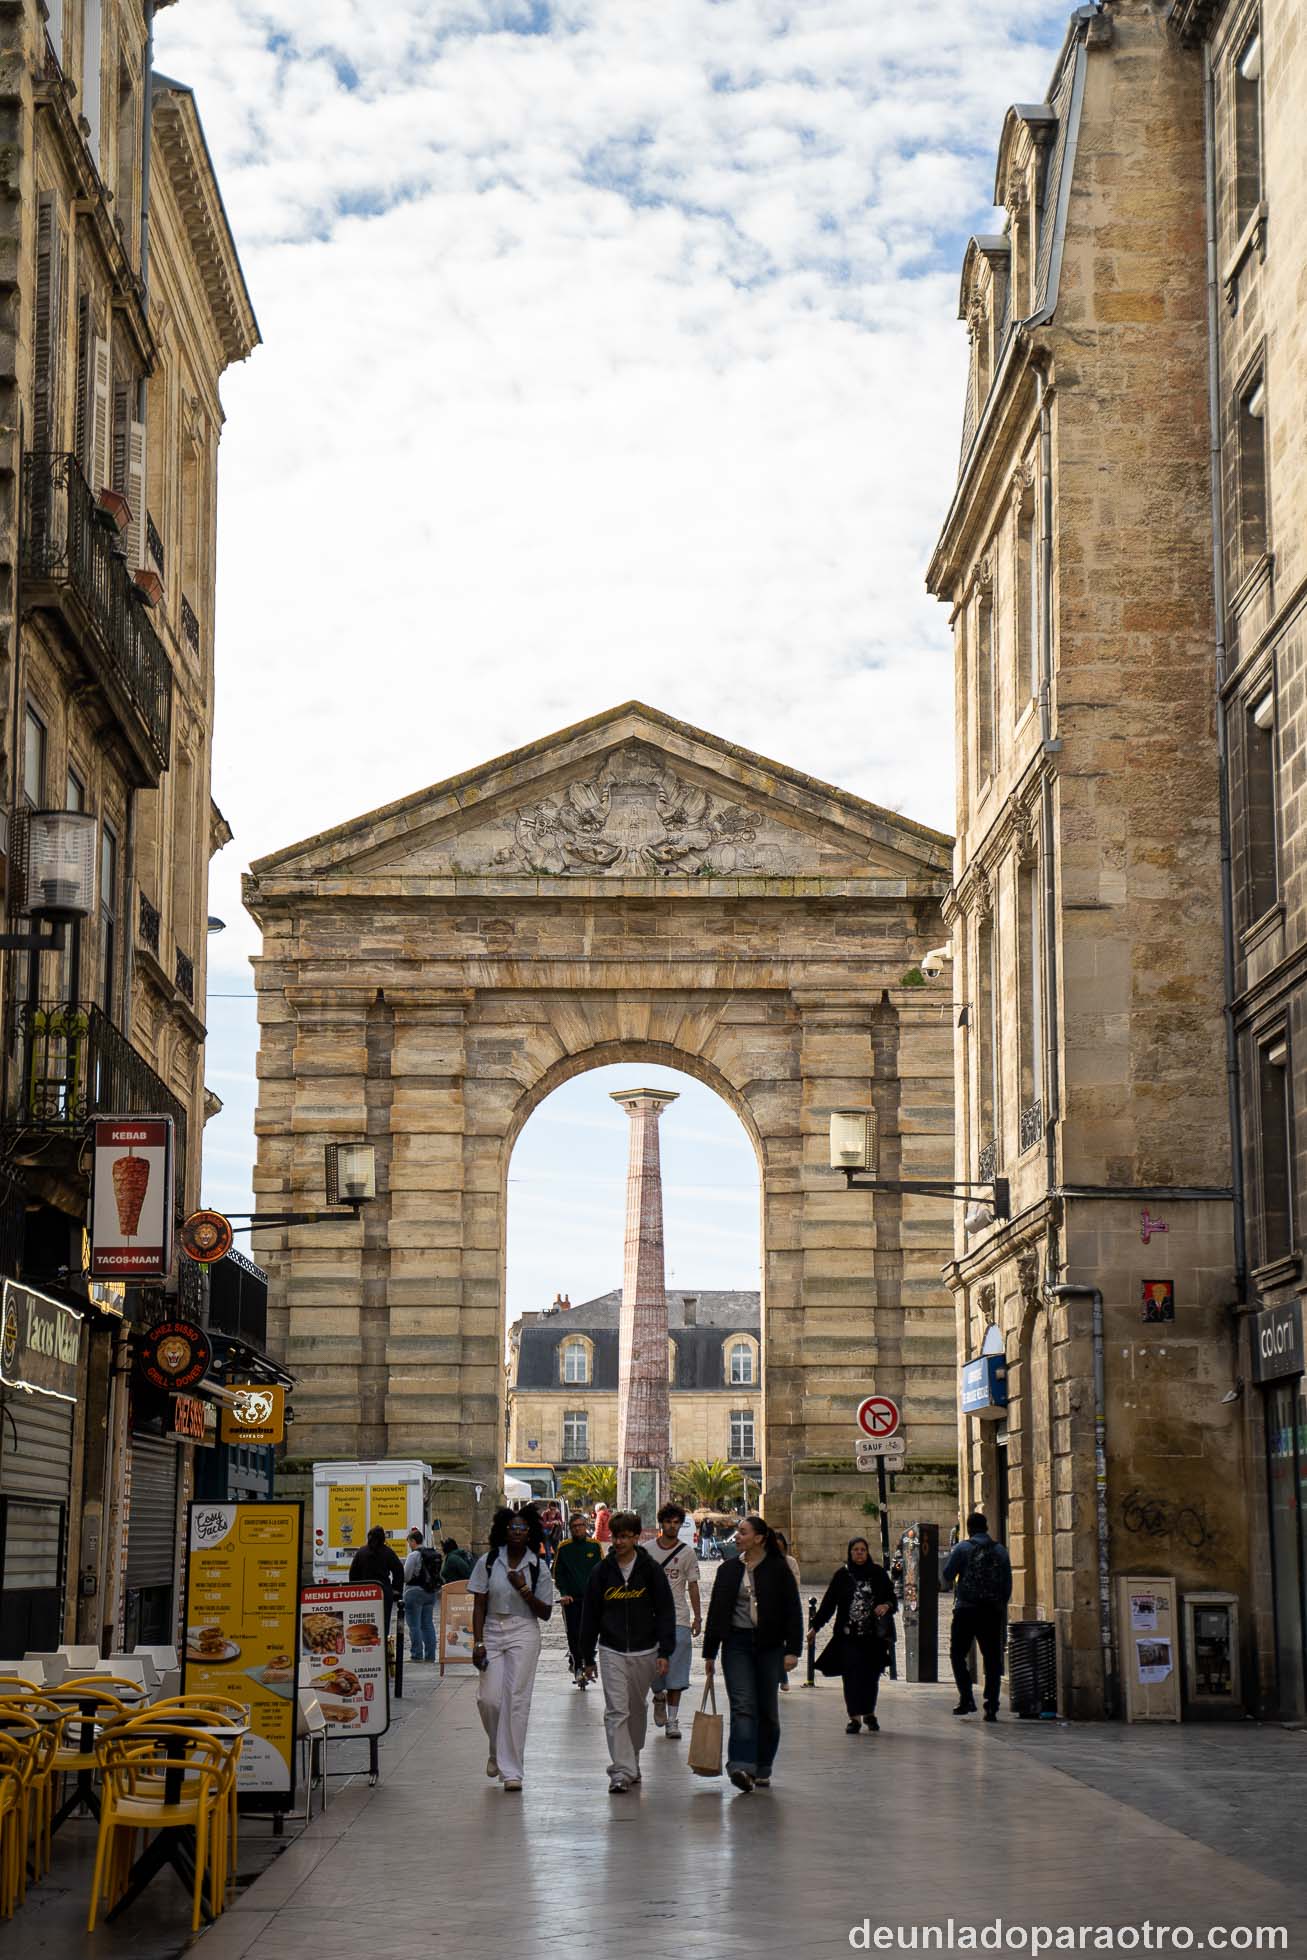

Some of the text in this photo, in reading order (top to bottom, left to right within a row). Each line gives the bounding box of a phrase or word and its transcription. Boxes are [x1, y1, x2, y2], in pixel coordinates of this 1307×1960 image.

[112, 1131, 147, 1140] KEBAB
[96, 1256, 160, 1264] TACOS-NAAN
[26, 1295, 79, 1366] Tacos Naan
[149, 1322, 199, 1341] CHEZ SISSO
[147, 1364, 203, 1387] GRILL DONER
[229, 1426, 274, 1434] columbus
[863, 1444, 883, 1452] SAUF
[304, 1589, 377, 1600] MENU ETUDIANT
[603, 1585, 646, 1600] Sunset
